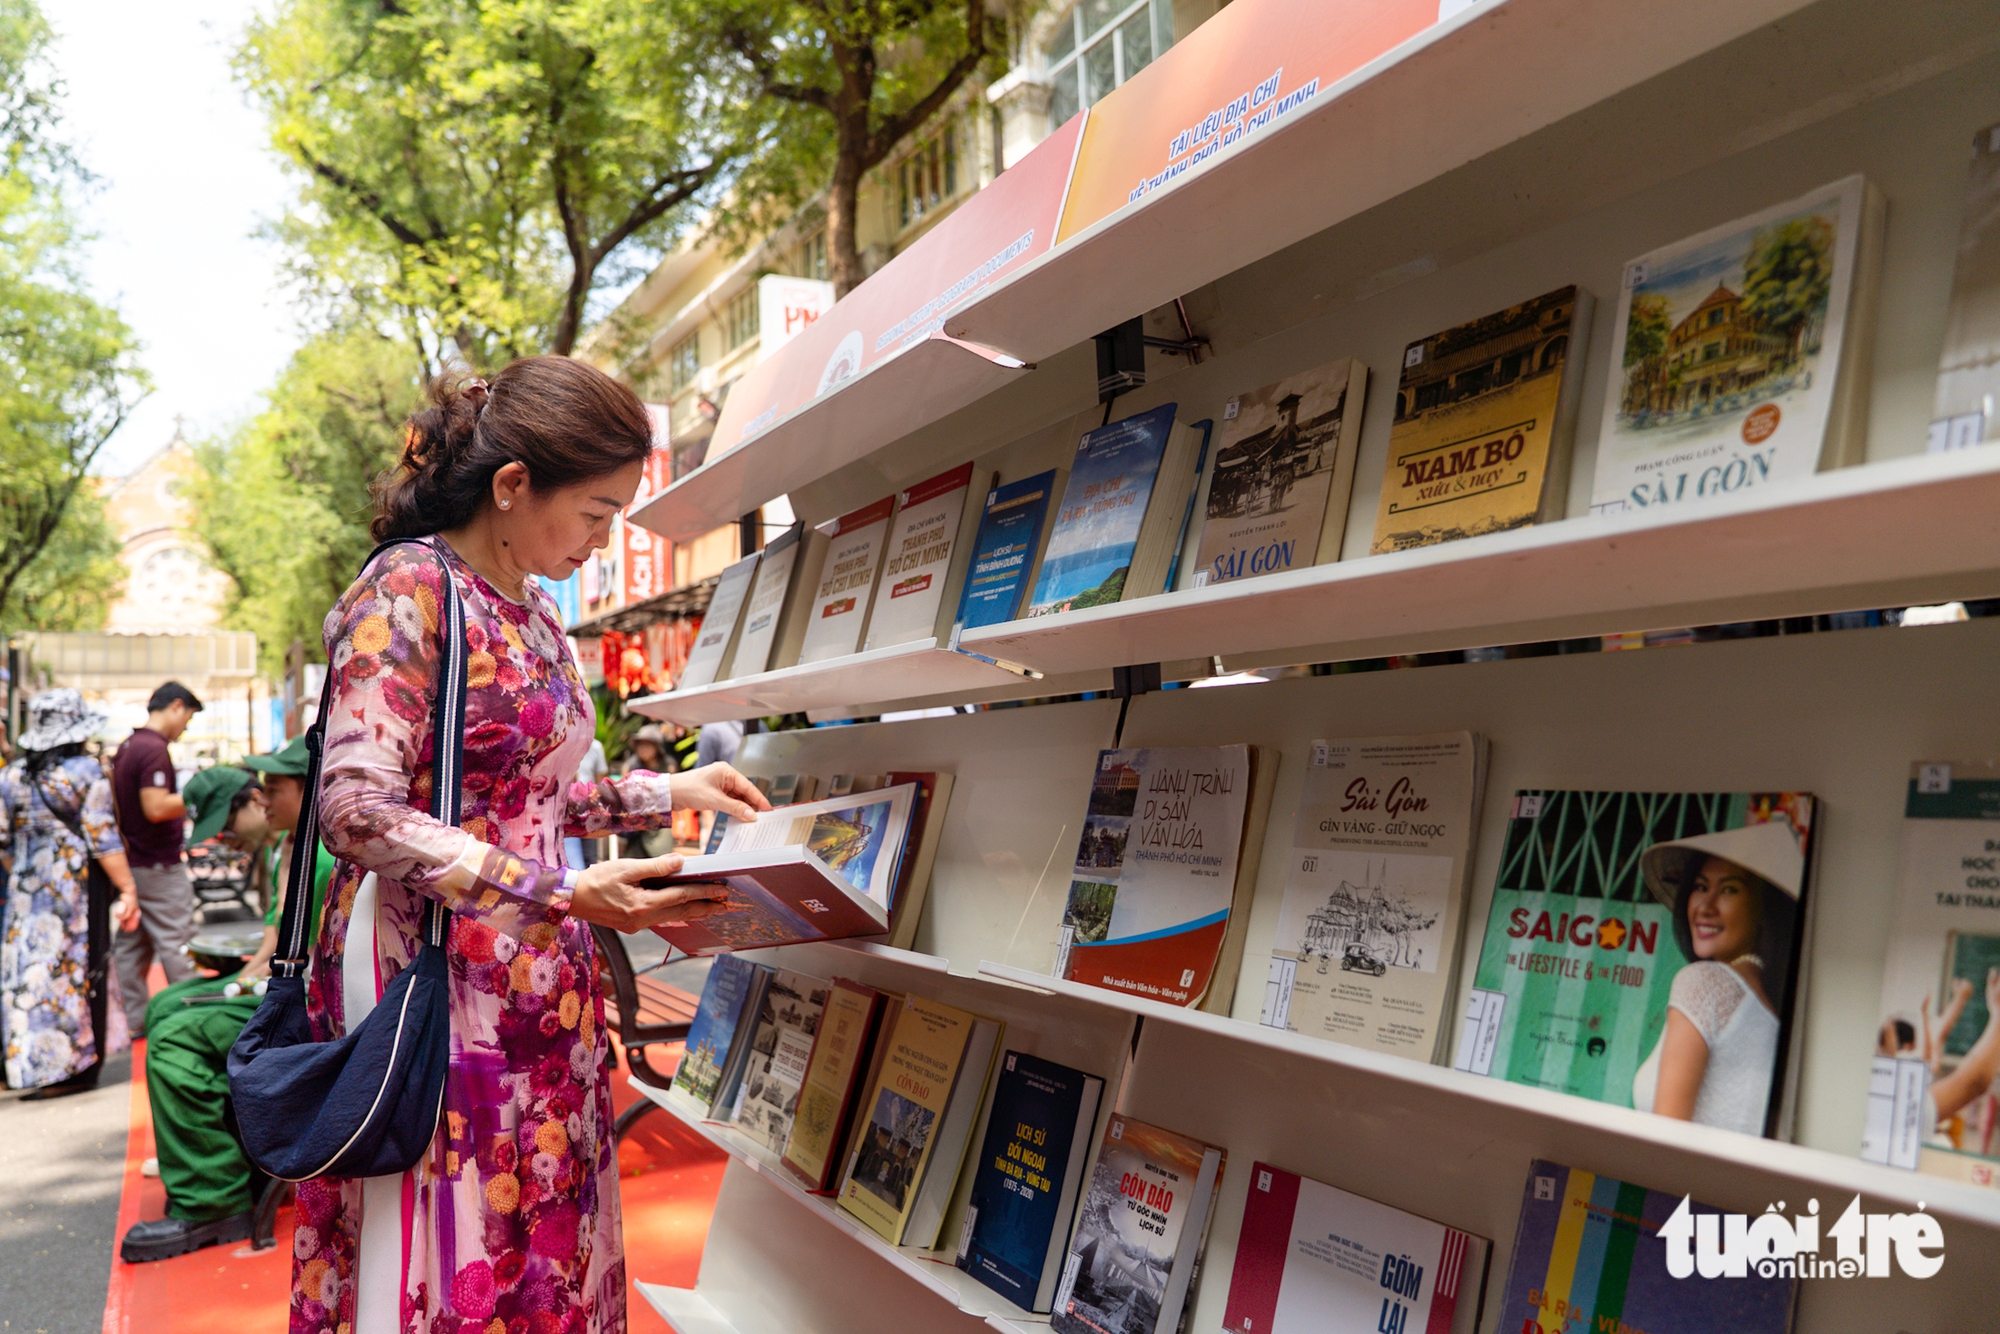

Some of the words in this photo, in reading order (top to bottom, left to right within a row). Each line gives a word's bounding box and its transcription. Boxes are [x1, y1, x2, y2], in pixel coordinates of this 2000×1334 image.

[1276, 80, 1318, 118] MINH
[1170, 130, 1190, 159] TÀI
[1193, 111, 1222, 145] LIỆU
[1225, 95, 1249, 125] ĐỊA
[1253, 68, 1282, 108] CHÍ
[982, 230, 1034, 278] DOCUMENTS
[1402, 446, 1482, 488] NAM
[1481, 430, 1524, 467] BỘ
[1083, 483, 1101, 500] ĐỊA
[1103, 472, 1124, 495] CHÍ
[1416, 477, 1451, 501] xưa
[1453, 475, 1466, 493] &
[1469, 468, 1503, 488] nay
[1630, 471, 1688, 509] SÀI
[1697, 448, 1776, 498] GÒN
[1061, 508, 1074, 523] BÀ
[1075, 506, 1087, 520] RỊA
[1092, 496, 1116, 516] VŨNG
[1118, 490, 1137, 507] TÀU
[902, 532, 929, 552] THÀNH
[928, 522, 945, 543] PHỐ
[833, 556, 855, 575] THÀNH
[855, 553, 868, 569] PHỐ
[887, 552, 903, 576] HỒ
[902, 546, 921, 573] CHÍ
[920, 541, 951, 567] MINH
[993, 545, 1005, 559] LỊCH
[1003, 554, 1024, 570] DƯƠNG
[1211, 547, 1247, 582] SÀI
[1251, 539, 1297, 575] GÒN
[849, 567, 872, 589] MINH
[1149, 768, 1190, 795] HÀNH
[1192, 767, 1235, 795] TRÌNH
[1159, 794, 1192, 822] SẢN
[1340, 776, 1380, 813] Sài
[1385, 776, 1430, 820] Gòn
[1526, 808, 1535, 816] 23
[1141, 822, 1172, 848] VĂN
[1172, 822, 1204, 850] HÓA
[1319, 817, 1340, 833] GÌN
[1343, 819, 1375, 834] VÀNG
[1385, 820, 1408, 836] GIỮ
[1409, 823, 1446, 839] NGỌC
[1330, 837, 1361, 846] PRESERVING
[1362, 838, 1373, 846] THE
[1373, 838, 1402, 847] BEAUTIFUL
[1403, 840, 1429, 848] CULTURE
[1135, 849, 1159, 861] THÀNH
[1159, 849, 1175, 863] PHỐ
[1176, 850, 1188, 864] HỒ
[1188, 851, 1202, 866] CHÍ
[1202, 854, 1223, 867] MINH
[1302, 860, 1315, 873] 01
[1506, 907, 1659, 955] SAIGON
[1506, 953, 1517, 965] THE
[1518, 953, 1580, 979] LIFESTYLE
[1584, 961, 1594, 981] &
[1611, 964, 1645, 988] FOOD
[1102, 975, 1114, 985] Nhà
[1114, 976, 1127, 988] xuất
[1126, 978, 1137, 990] bản
[1137, 981, 1148, 992] Văn
[1148, 984, 1159, 995] hóa
[1162, 986, 1173, 998] Văn
[1173, 989, 1188, 1002] nghệ
[896, 1072, 912, 1092] CÔN
[912, 1080, 930, 1100] ĐẢO
[1016, 1121, 1033, 1143] LỊCH
[1034, 1126, 1047, 1147] SỬ
[1007, 1139, 1022, 1158] ĐỐI
[1021, 1148, 1046, 1174] NGOẠI
[994, 1154, 1006, 1173] TỈNH
[1026, 1167, 1040, 1188] VŨNG
[1040, 1174, 1051, 1193] TÀU
[1003, 1178, 1018, 1193] (1975
[1260, 1182, 1268, 1190] 27
[1541, 1178, 1549, 1187] TL
[1119, 1171, 1147, 1202] CÔN
[1146, 1181, 1173, 1214] ĐẢO
[1127, 1199, 1136, 1211] TỪ
[1136, 1202, 1150, 1218] GÓC
[1151, 1210, 1168, 1226] NHÌN
[1139, 1218, 1154, 1233] LỊCH
[1154, 1222, 1166, 1237] SỬ
[1380, 1252, 1424, 1302] GỐM
[1377, 1298, 1409, 1334] LÁI
[1527, 1287, 1549, 1312] BÀ
[1554, 1298, 1582, 1325] RỊA
[1598, 1314, 1650, 1334] VŨN
